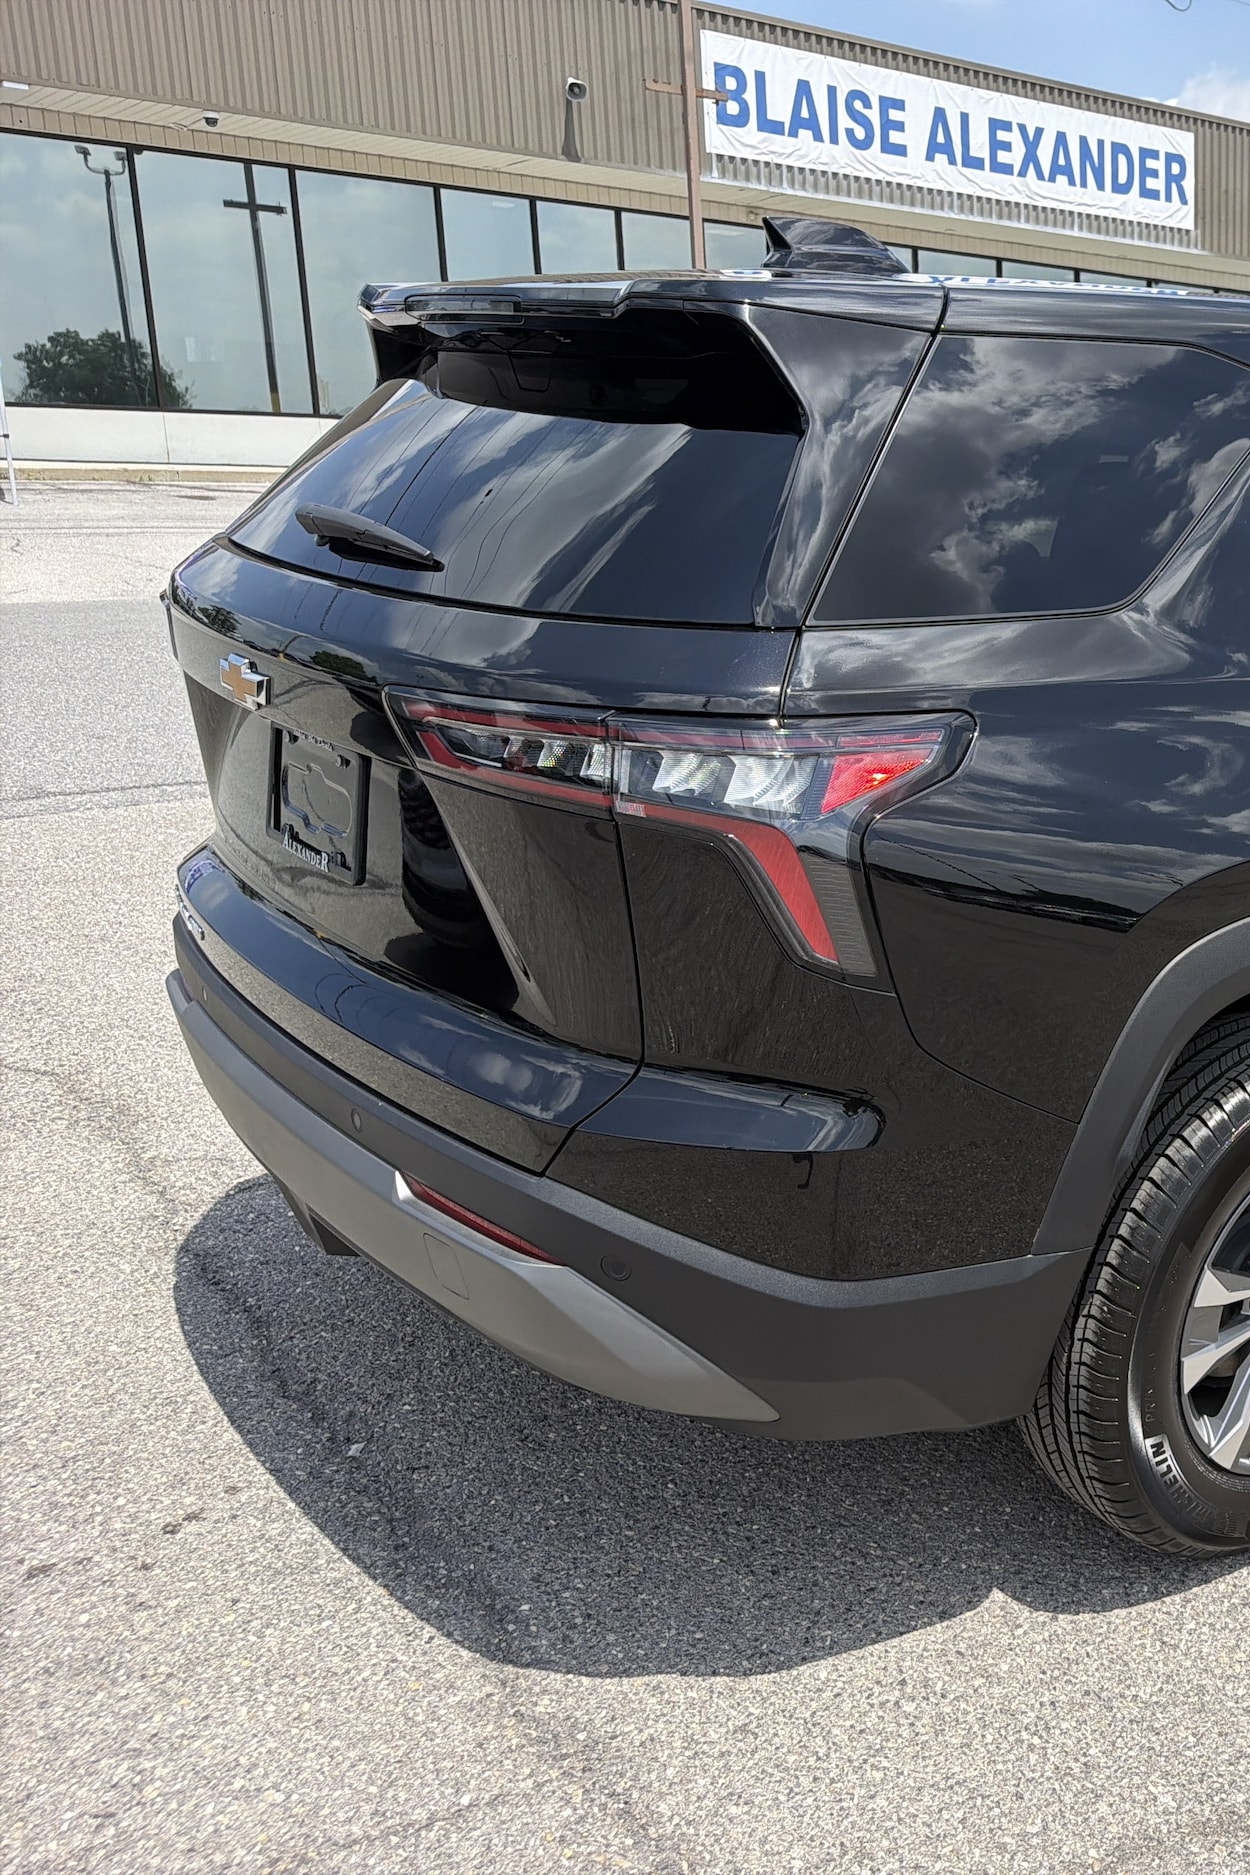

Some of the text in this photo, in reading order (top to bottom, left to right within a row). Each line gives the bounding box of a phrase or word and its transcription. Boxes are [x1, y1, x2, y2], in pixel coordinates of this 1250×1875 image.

[714, 61, 1188, 206] BLAISE ALEXANDER
[283, 832, 329, 873] ALEXANDER
